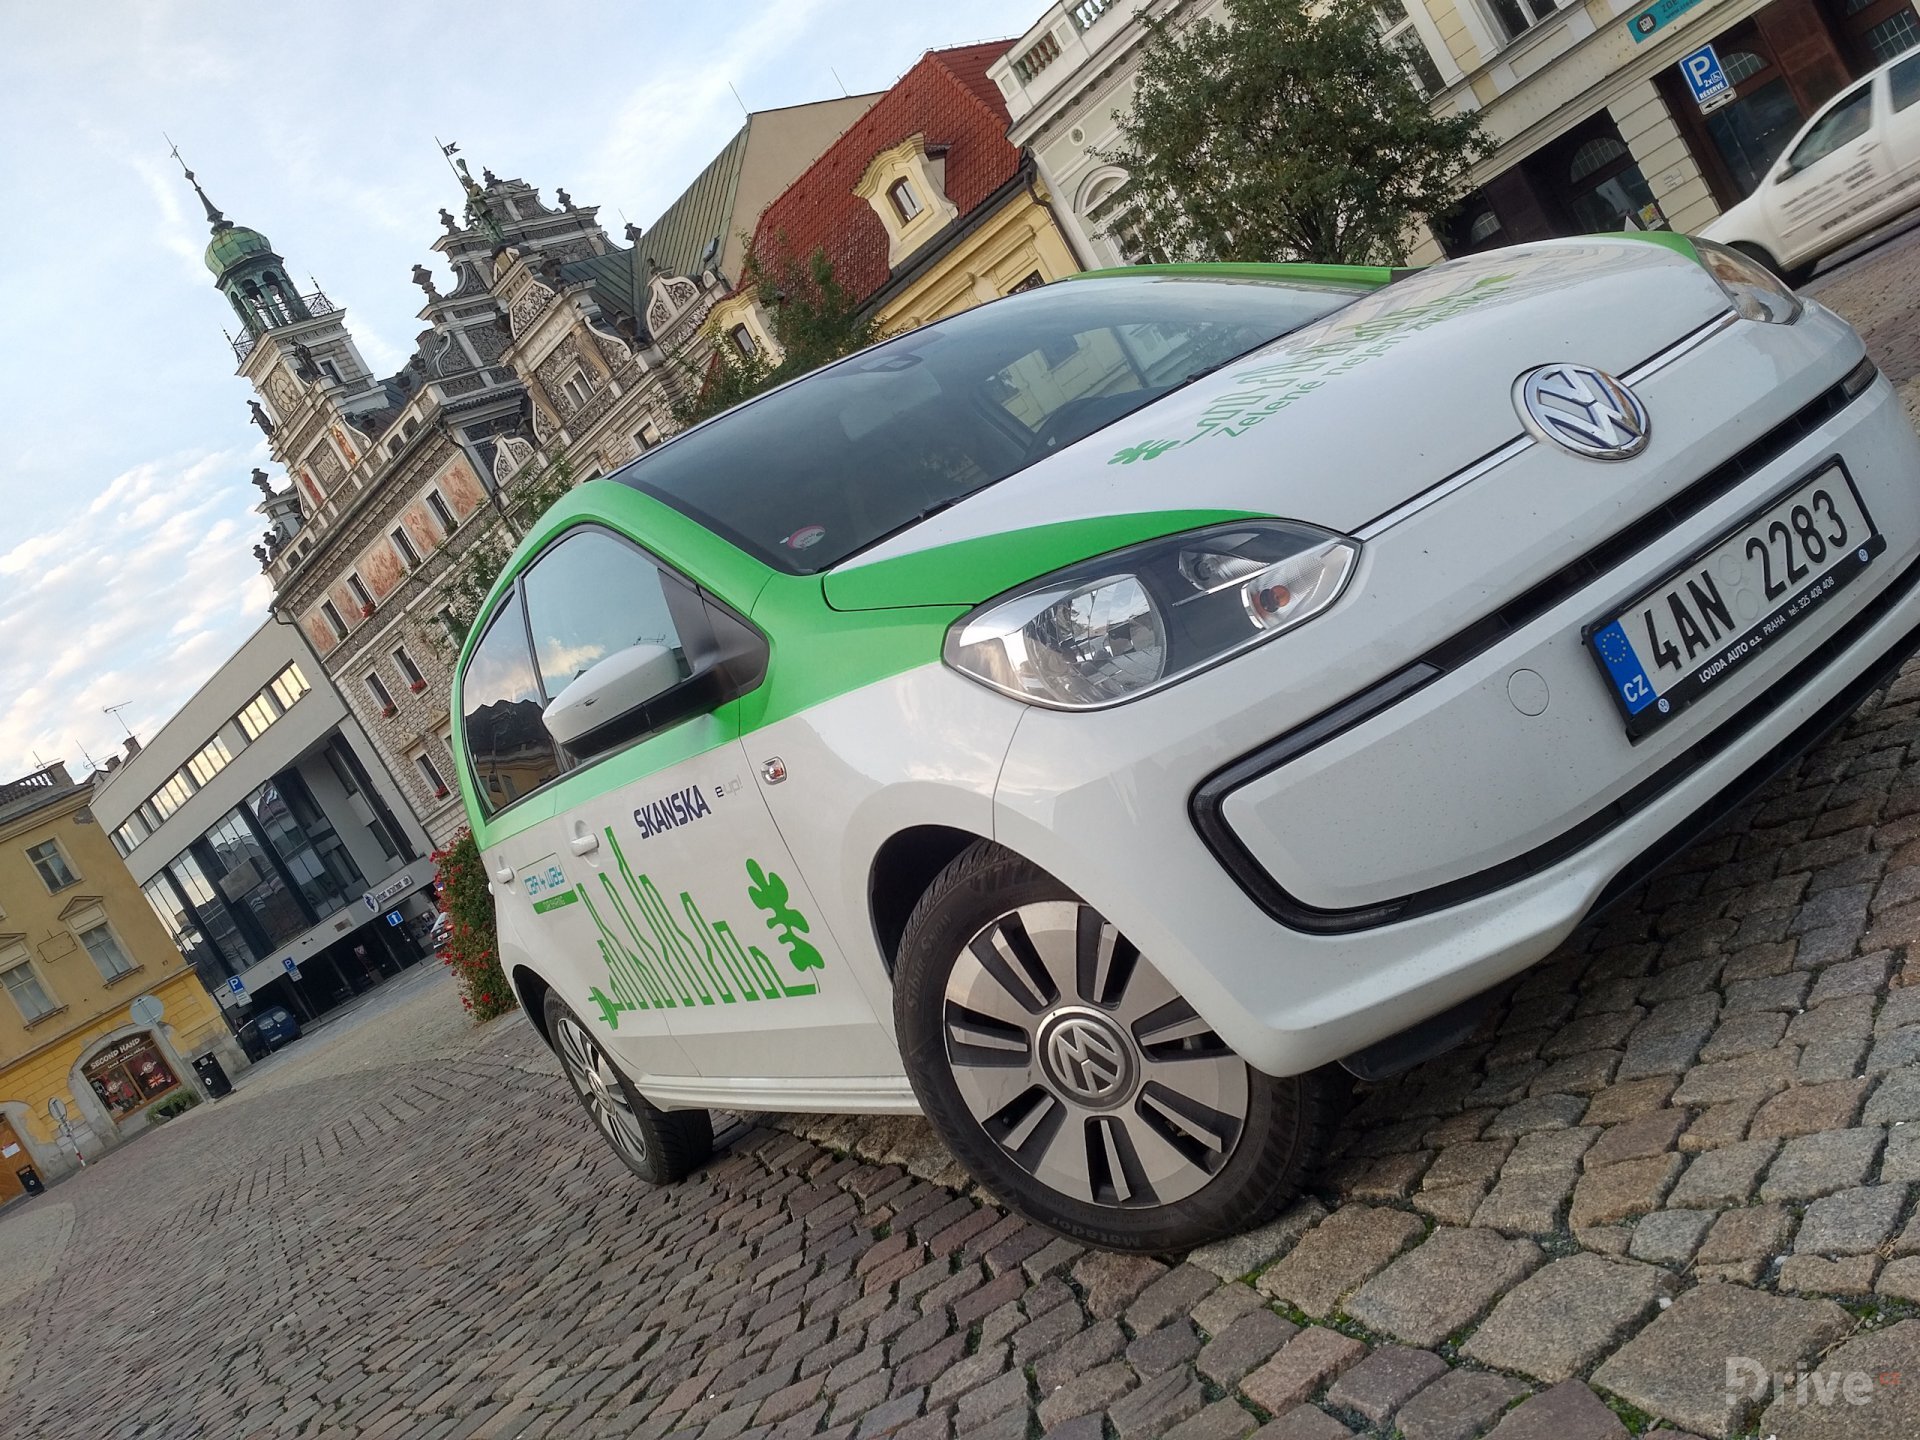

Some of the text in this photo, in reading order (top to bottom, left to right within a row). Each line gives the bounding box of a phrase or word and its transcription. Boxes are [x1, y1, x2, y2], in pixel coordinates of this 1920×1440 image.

[1689, 56, 1710, 87] P
[1704, 79, 1713, 87] 2x
[1211, 380, 1326, 438] Zelené
[1320, 335, 1411, 376] nejen
[1643, 489, 1848, 671] 4AN 2283
[1698, 658, 1728, 684] LOUDA
[1727, 641, 1749, 663] AUTO
[1762, 614, 1786, 636] PRAHA
[1788, 604, 1800, 617] tel:
[1797, 594, 1811, 610] 325
[1810, 585, 1823, 599] 408
[1822, 575, 1835, 590] 408
[1622, 673, 1649, 703] CZ
[633, 784, 712, 840] SKANSKA
[283, 959, 292, 969] P
[229, 978, 238, 990] P
[90, 1049, 120, 1070] SECOND
[119, 1037, 140, 1054] HAND
